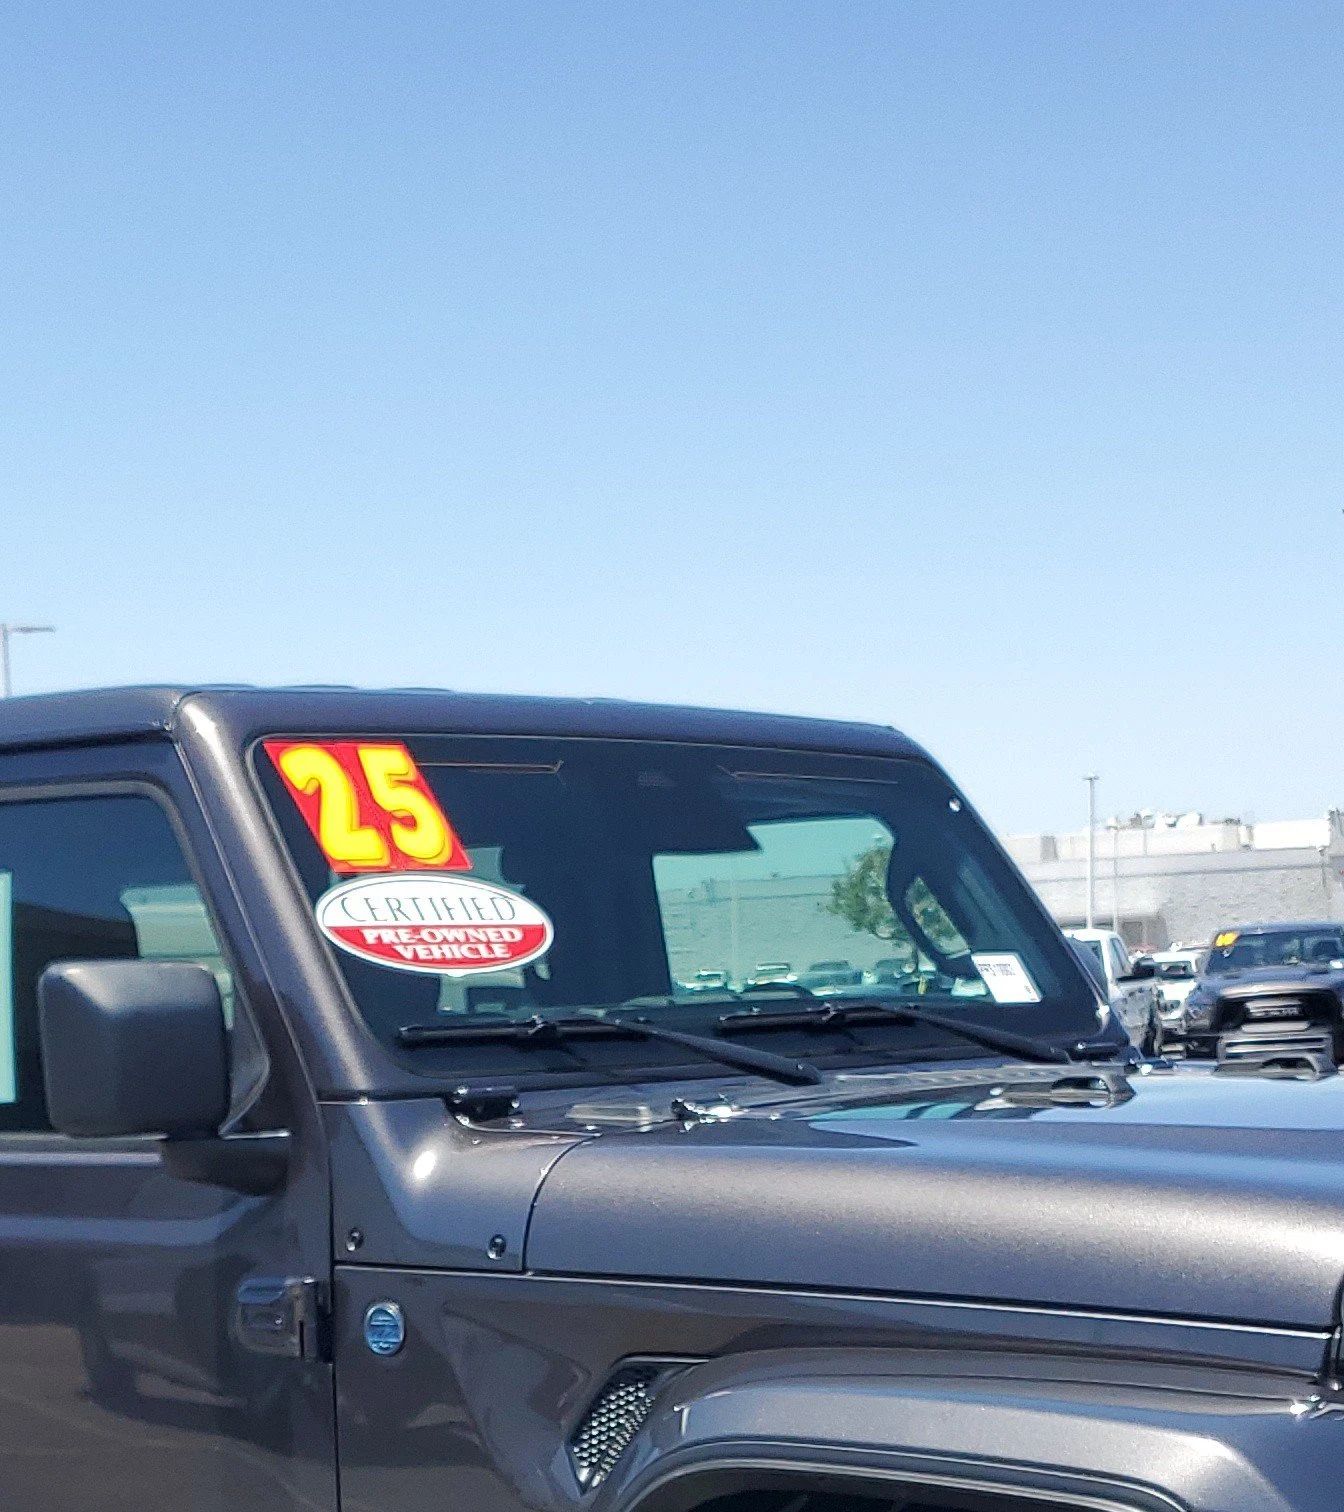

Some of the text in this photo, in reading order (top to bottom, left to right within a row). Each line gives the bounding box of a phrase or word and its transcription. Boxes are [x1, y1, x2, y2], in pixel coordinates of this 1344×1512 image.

[279, 744, 453, 866] 25
[341, 896, 516, 922] CERTIFIED
[360, 927, 526, 943] PRE-OWNED
[394, 943, 511, 960] VEHICLE
